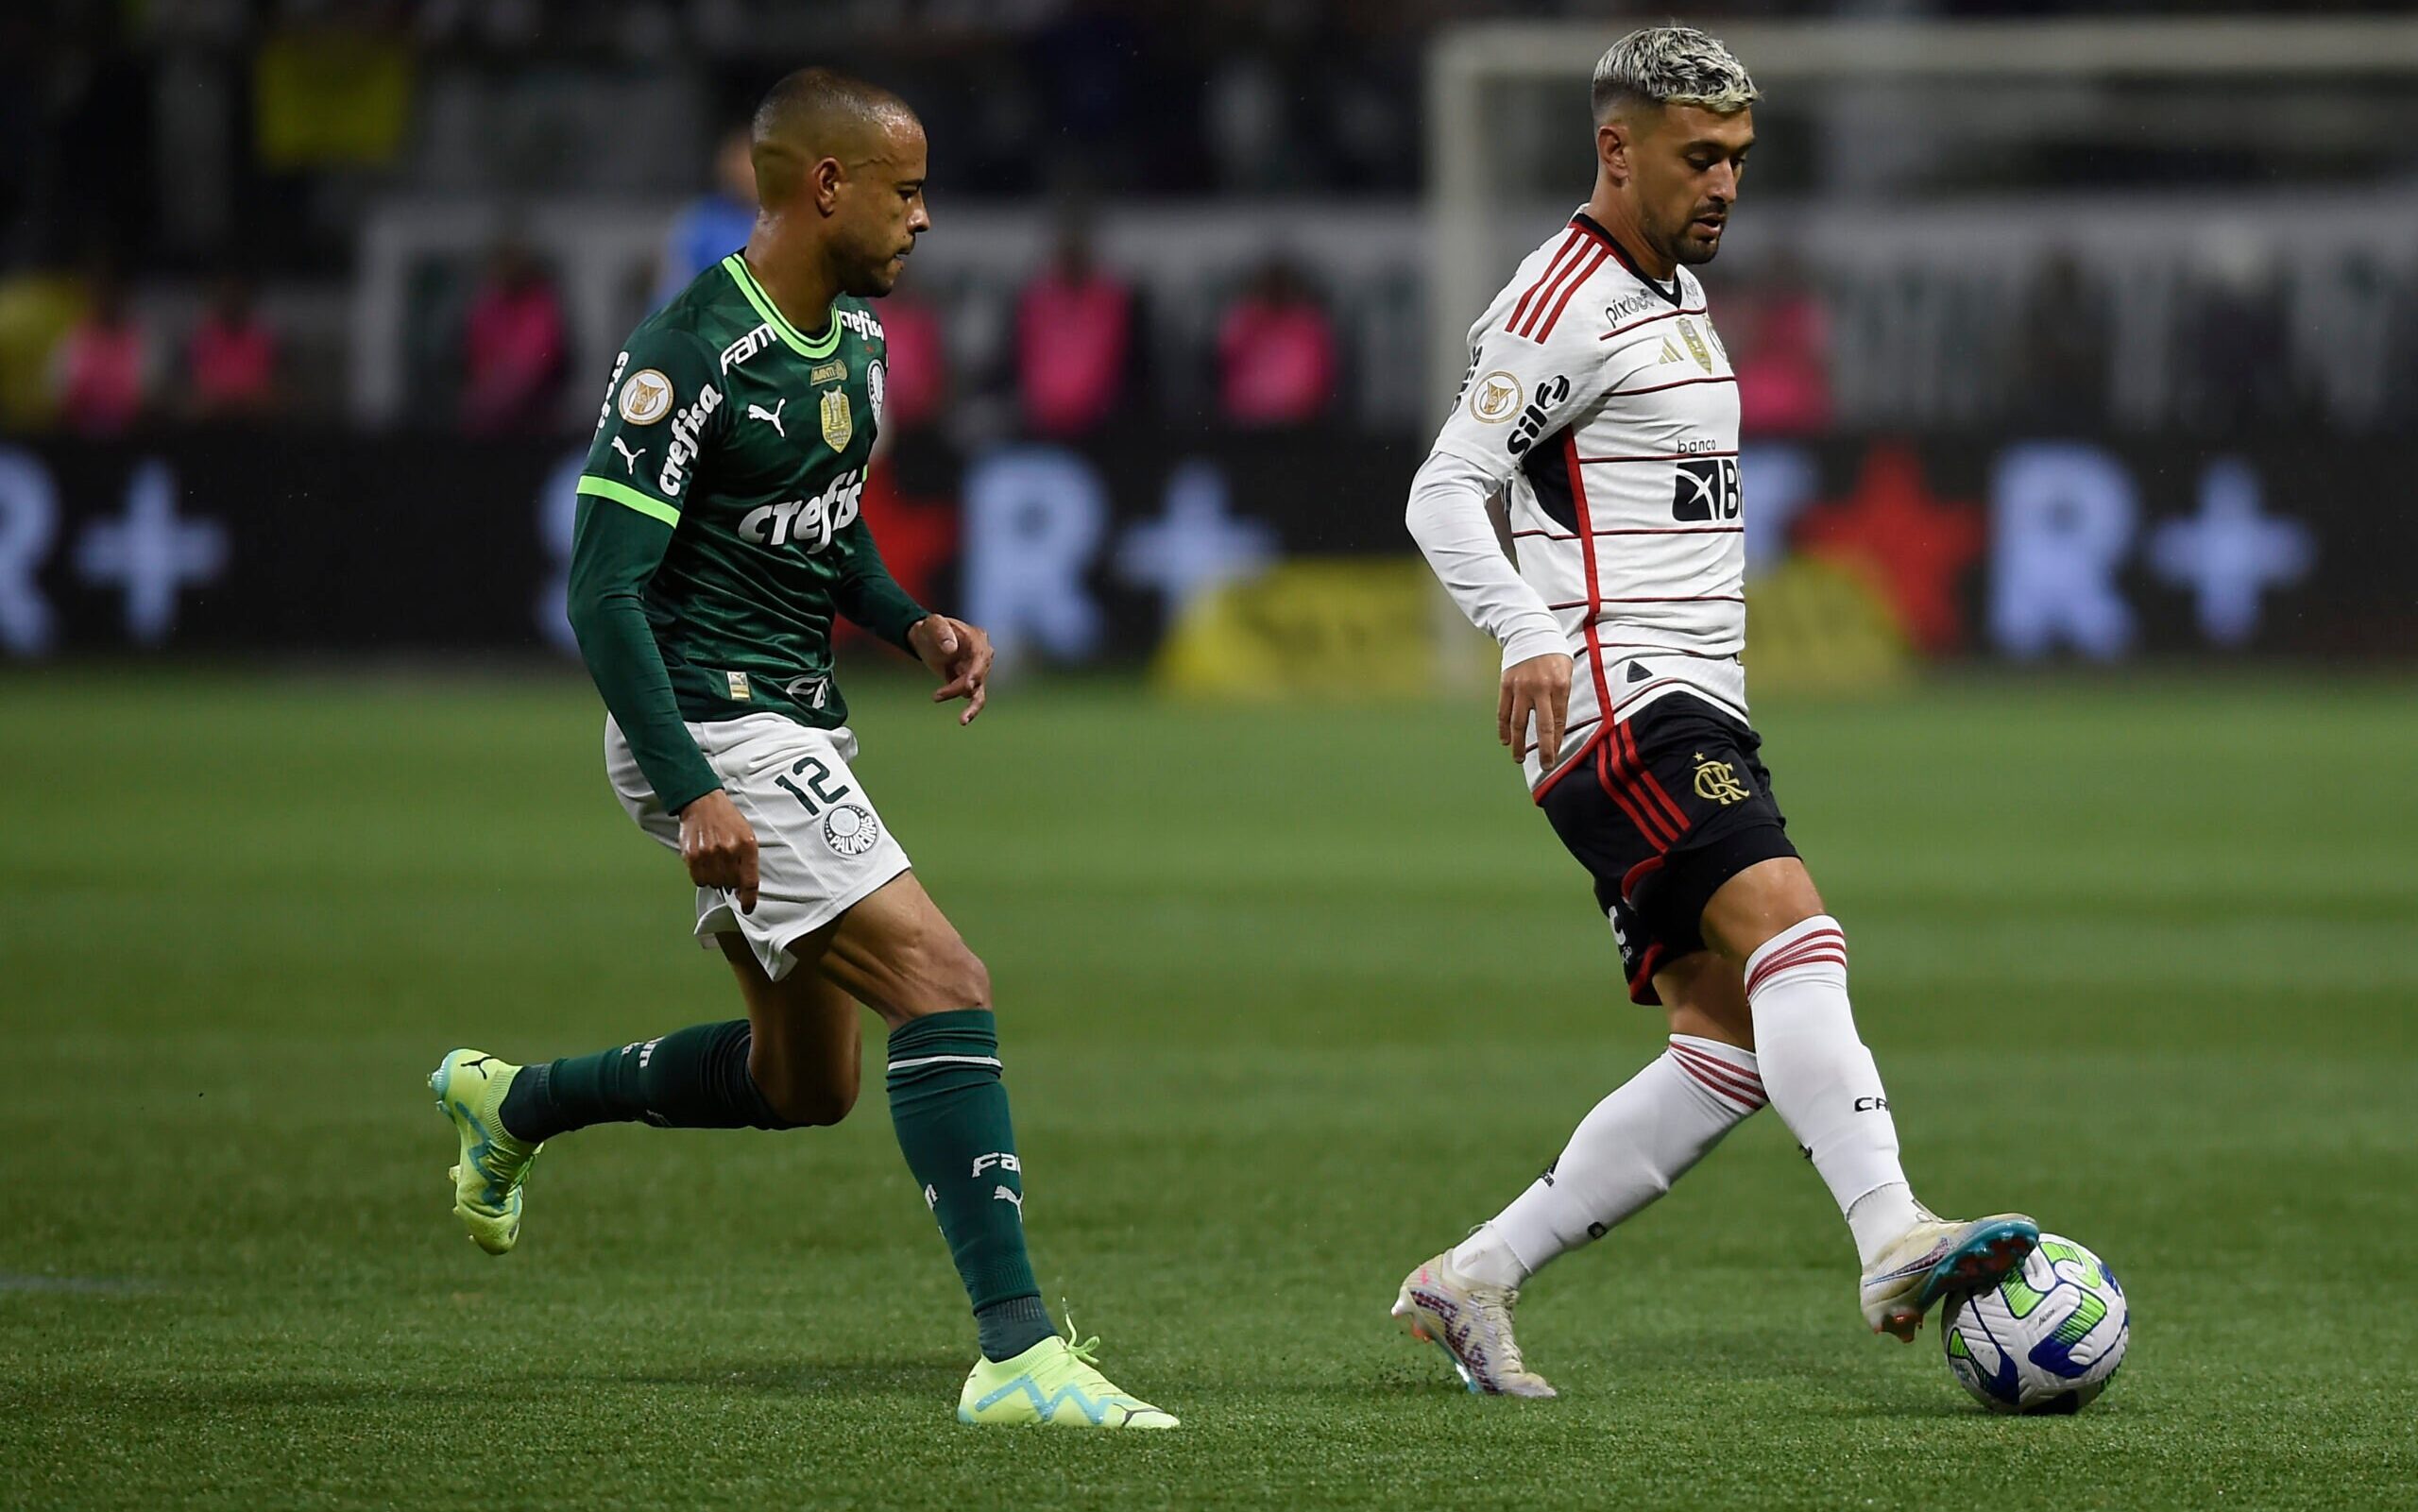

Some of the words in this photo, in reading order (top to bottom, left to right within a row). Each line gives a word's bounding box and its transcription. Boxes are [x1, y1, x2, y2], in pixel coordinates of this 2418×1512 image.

[659, 383, 724, 497] crefisa
[1677, 439, 1716, 453] banco
[775, 756, 850, 816] 12
